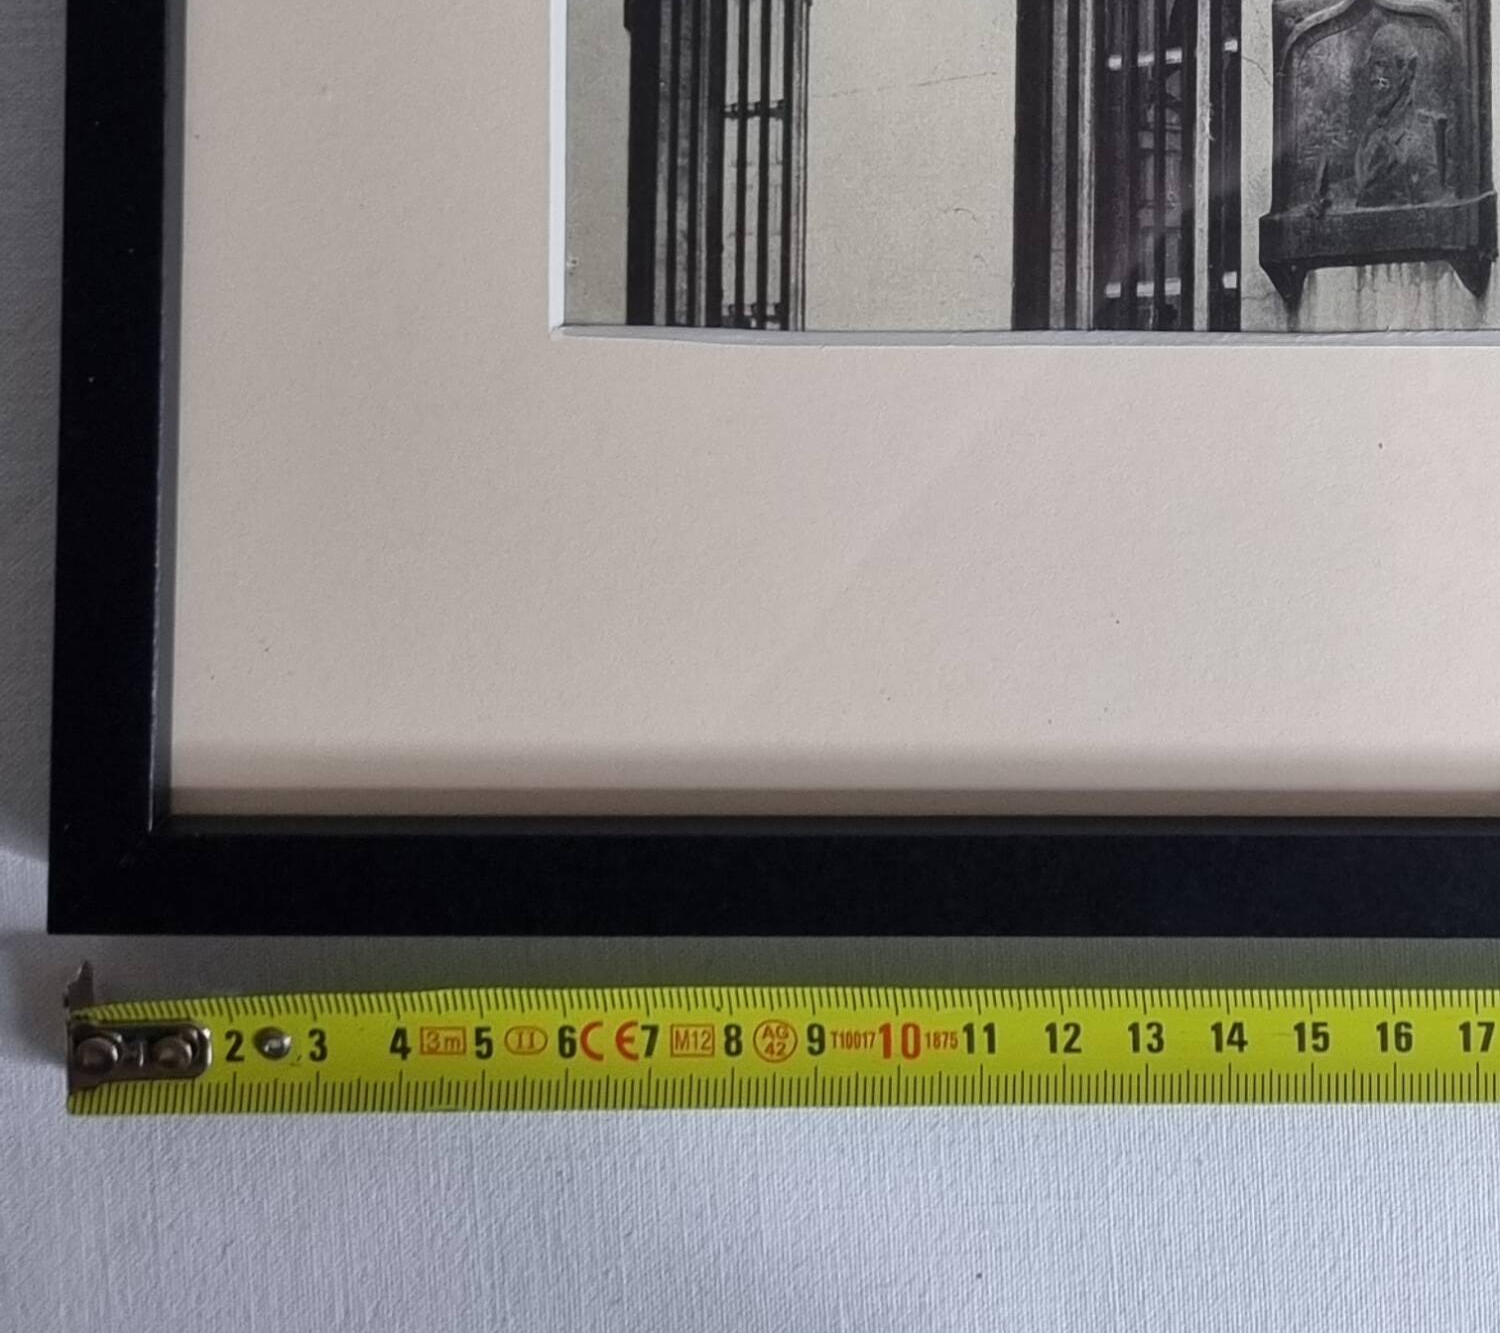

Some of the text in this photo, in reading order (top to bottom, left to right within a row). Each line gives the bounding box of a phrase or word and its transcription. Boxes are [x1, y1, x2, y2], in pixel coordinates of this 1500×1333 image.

[224, 1029, 245, 1063] 2
[308, 1028, 327, 1062] 3
[389, 1027, 412, 1061] 4
[475, 1026, 493, 1060] 5
[558, 1025, 577, 1059] 6
[580, 1020, 639, 1062] CE
[641, 1024, 659, 1058] 7
[724, 1023, 743, 1057] 8
[807, 1023, 826, 1057] 9
[879, 1022, 921, 1060] 10
[926, 1031, 958, 1050] 1875
[963, 1022, 996, 1054] 11
[1045, 1022, 1082, 1054] 12
[1128, 1021, 1164, 1054] 13
[1211, 1021, 1248, 1053] 14
[1293, 1021, 1330, 1053] 15
[1376, 1021, 1413, 1053] 16
[1459, 1021, 1495, 1053] 17
[765, 1041, 787, 1056] 42
